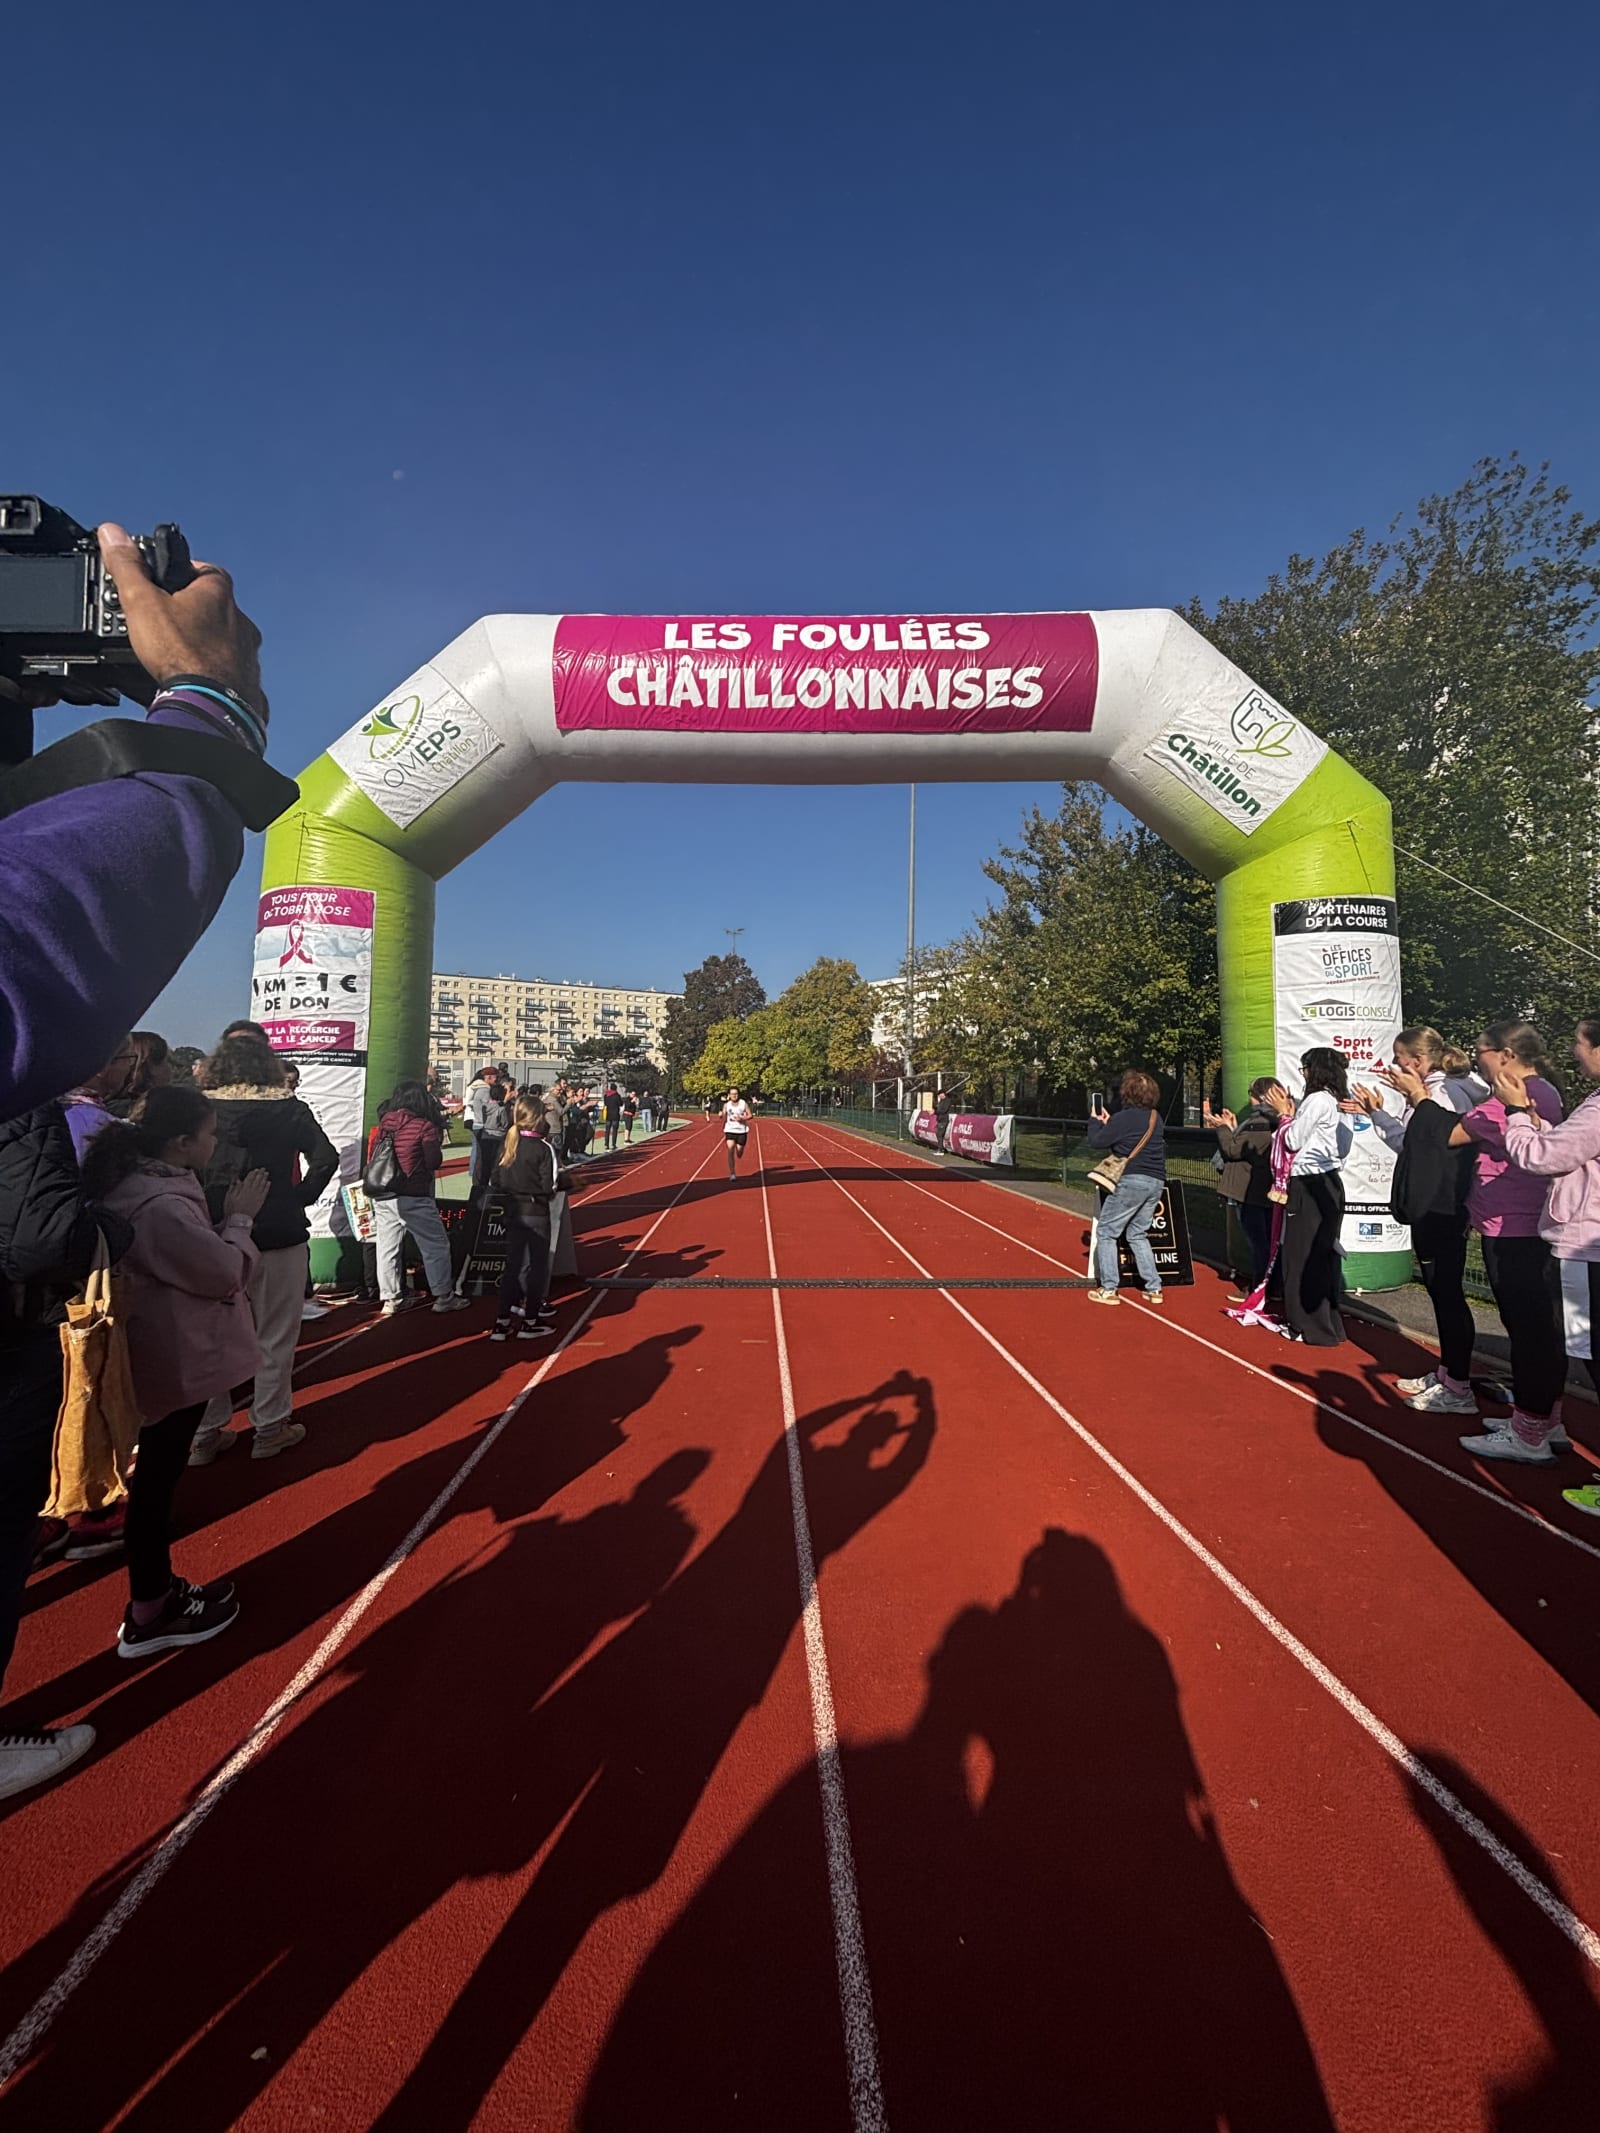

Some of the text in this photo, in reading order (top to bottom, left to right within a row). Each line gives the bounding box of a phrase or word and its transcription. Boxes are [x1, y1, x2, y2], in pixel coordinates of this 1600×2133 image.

[663, 617, 990, 651] LES FOULÉES
[606, 658, 1044, 711] CHÂTILLONNAISES
[384, 719, 461, 788] OMEPS
[1207, 734, 1257, 780] VILLE DE
[1167, 733, 1262, 816] Châtillon
[271, 891, 338, 905] TOUS POUR
[1307, 903, 1387, 916] PARTENAIRES
[1305, 916, 1388, 928] DE LA COURSE
[1330, 944, 1342, 952] LES
[1322, 947, 1372, 967] OFFICES
[1334, 961, 1373, 979] SPORT
[263, 978, 286, 994] KM
[317, 973, 329, 992] 1
[339, 974, 358, 993] €
[264, 996, 330, 1012] DE DON
[270, 1036, 282, 1044] TRE
[1333, 1036, 1373, 1049] Sport
[1345, 1047, 1373, 1060] nète
[1154, 1252, 1179, 1264] LINE
